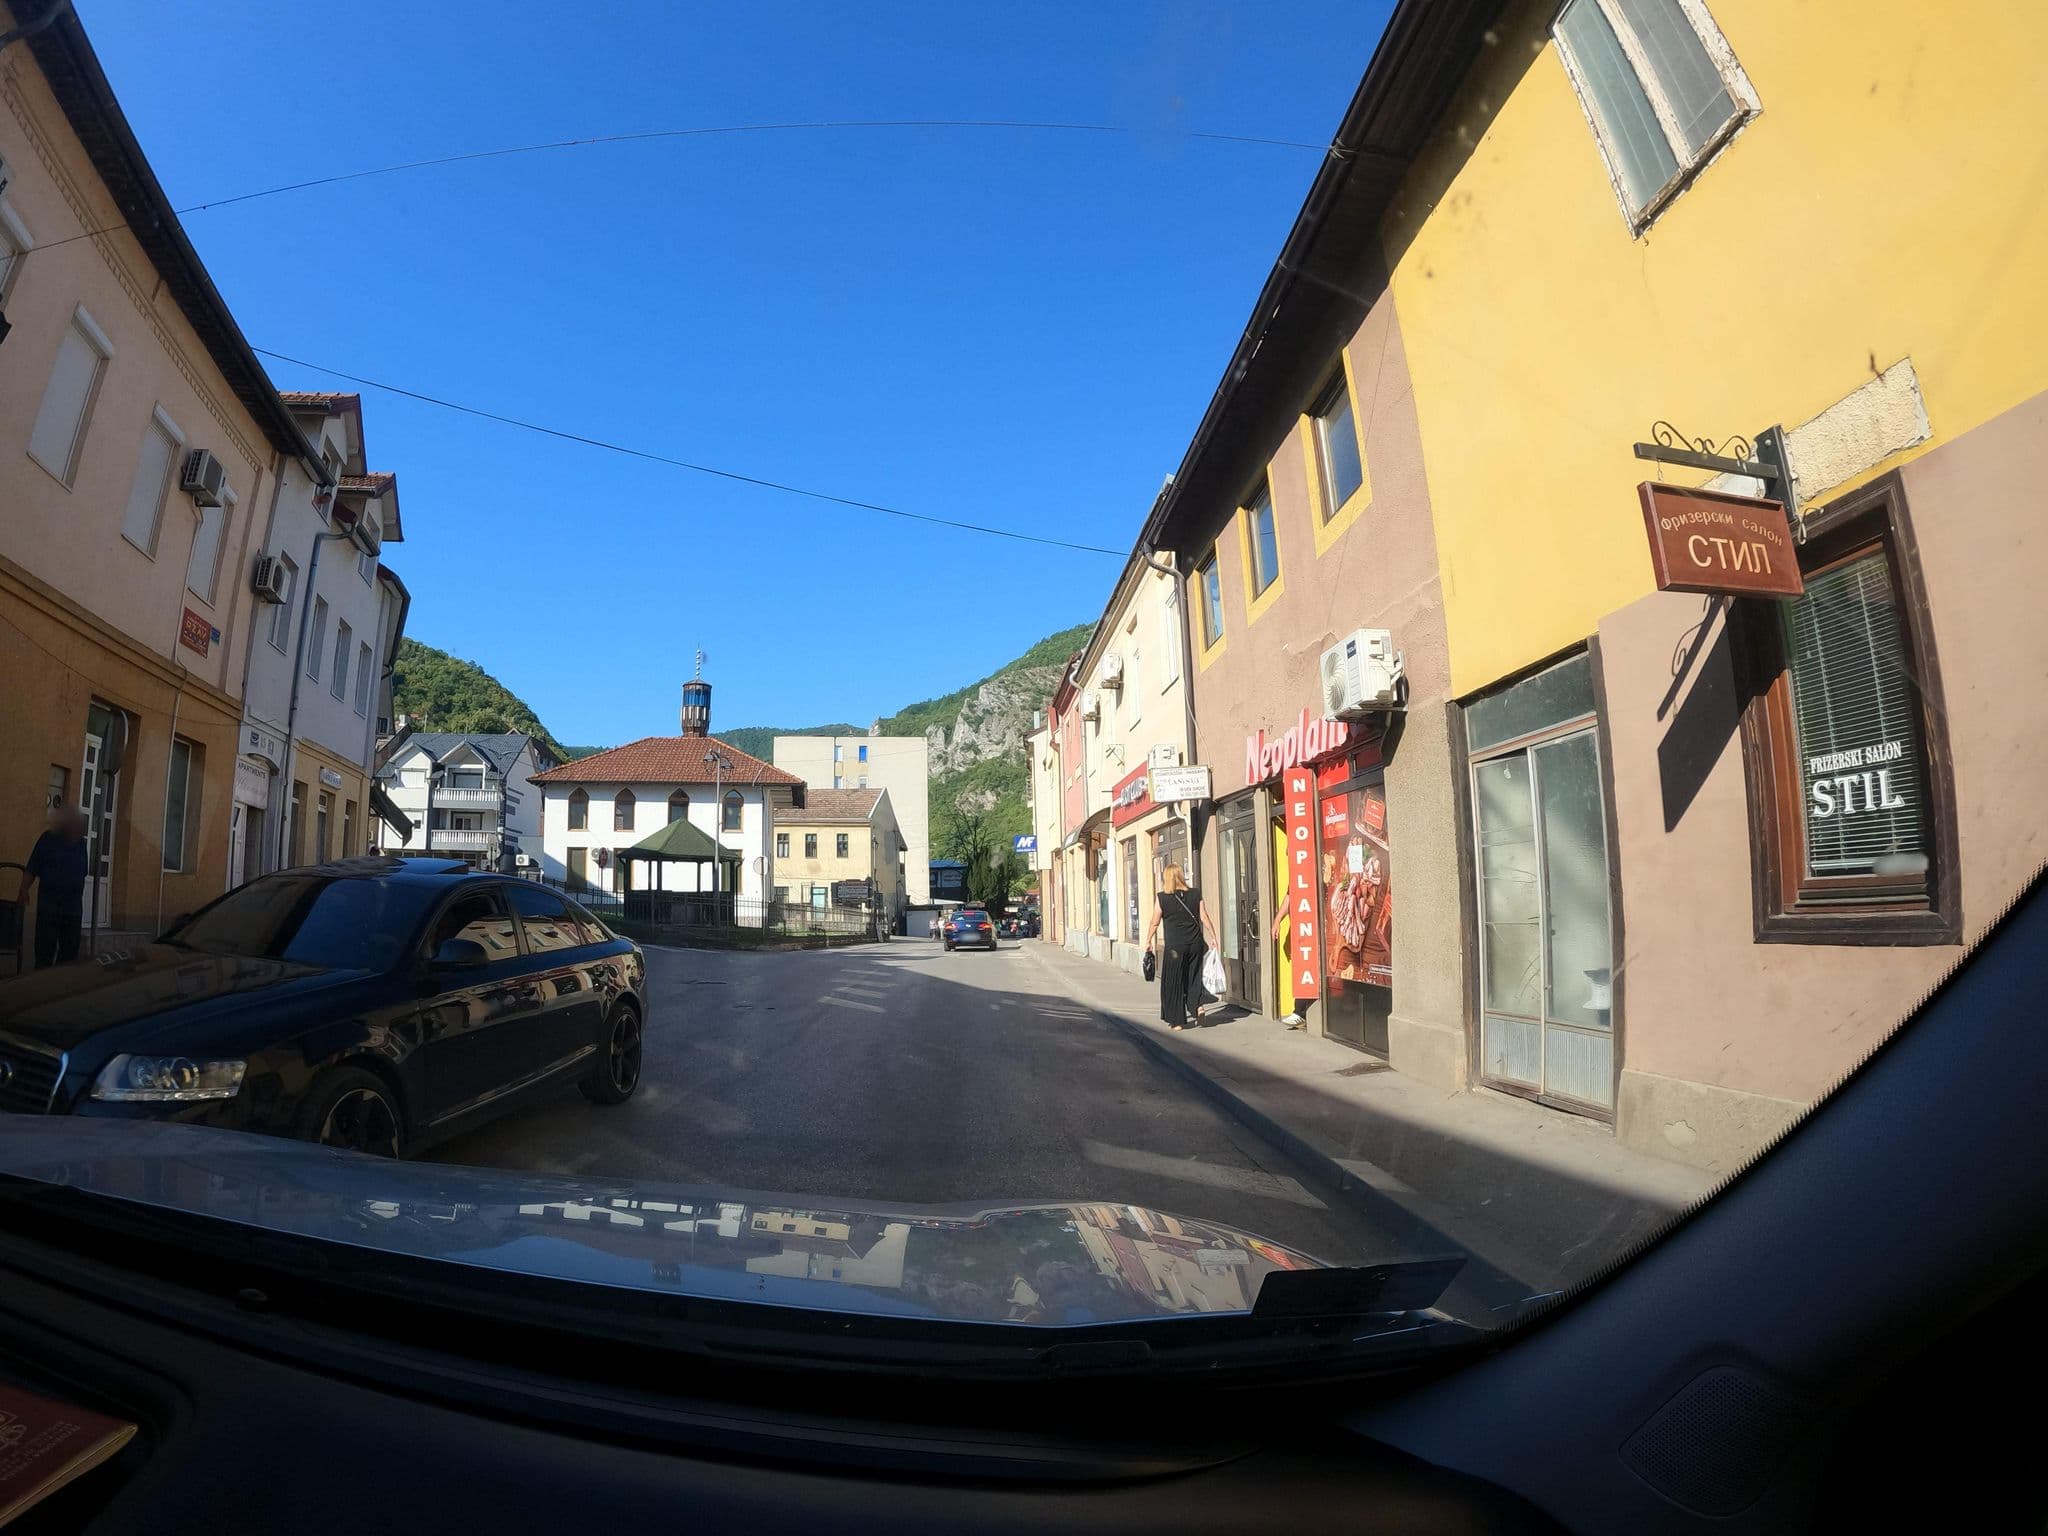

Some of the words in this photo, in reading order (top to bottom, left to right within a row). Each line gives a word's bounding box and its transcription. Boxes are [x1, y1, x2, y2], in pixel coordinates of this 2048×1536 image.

[1742, 518, 1783, 546] салон
[1688, 534, 1772, 575] СТИЛ
[1810, 749, 1863, 774] FRIZERSKI
[1865, 741, 1902, 764] SALON
[1812, 770, 1906, 817] STIL
[1292, 778, 1315, 986] NEOPLANTA
